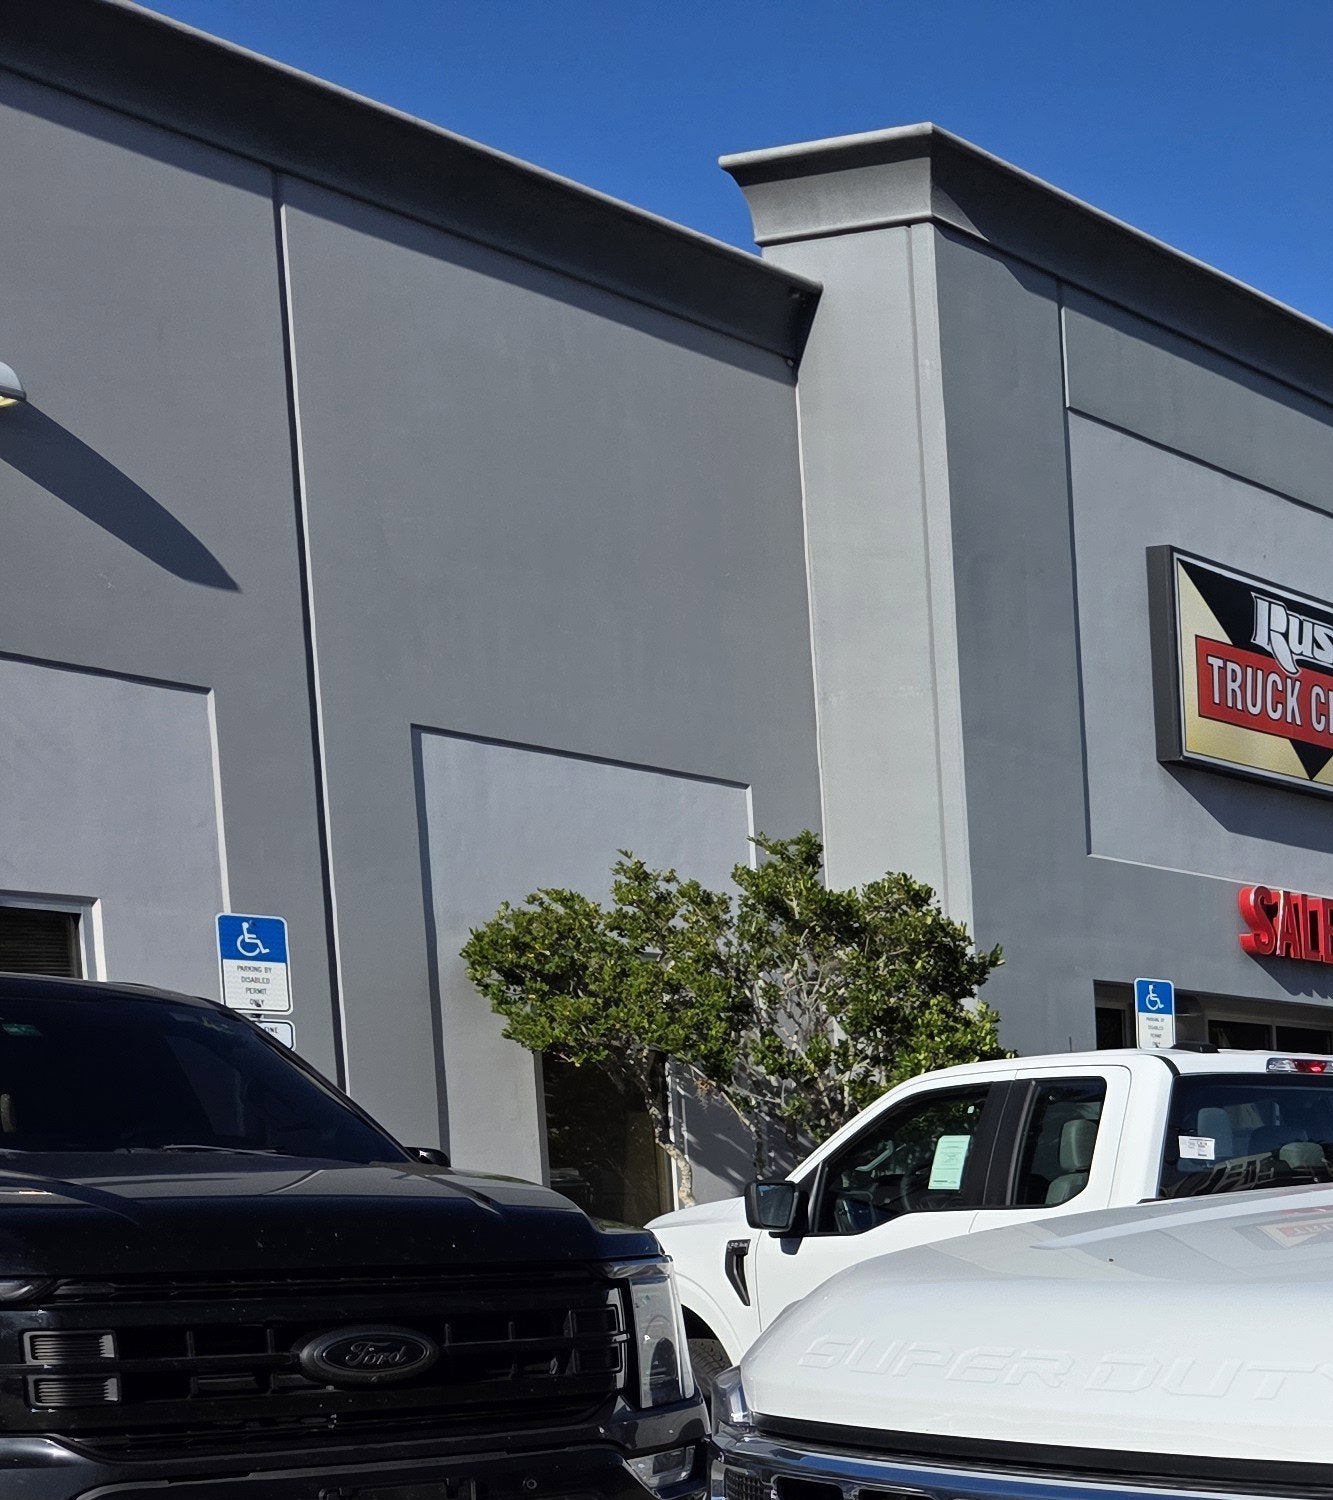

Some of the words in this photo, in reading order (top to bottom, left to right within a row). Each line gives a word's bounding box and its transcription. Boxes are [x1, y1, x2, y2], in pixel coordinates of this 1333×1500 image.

[1207, 653, 1302, 726] TRUCK
[237, 965, 262, 974] PARKING
[241, 976, 271, 985] DISABLED
[345, 1341, 407, 1366] Ford
[798, 1334, 1074, 1388] SUPER
